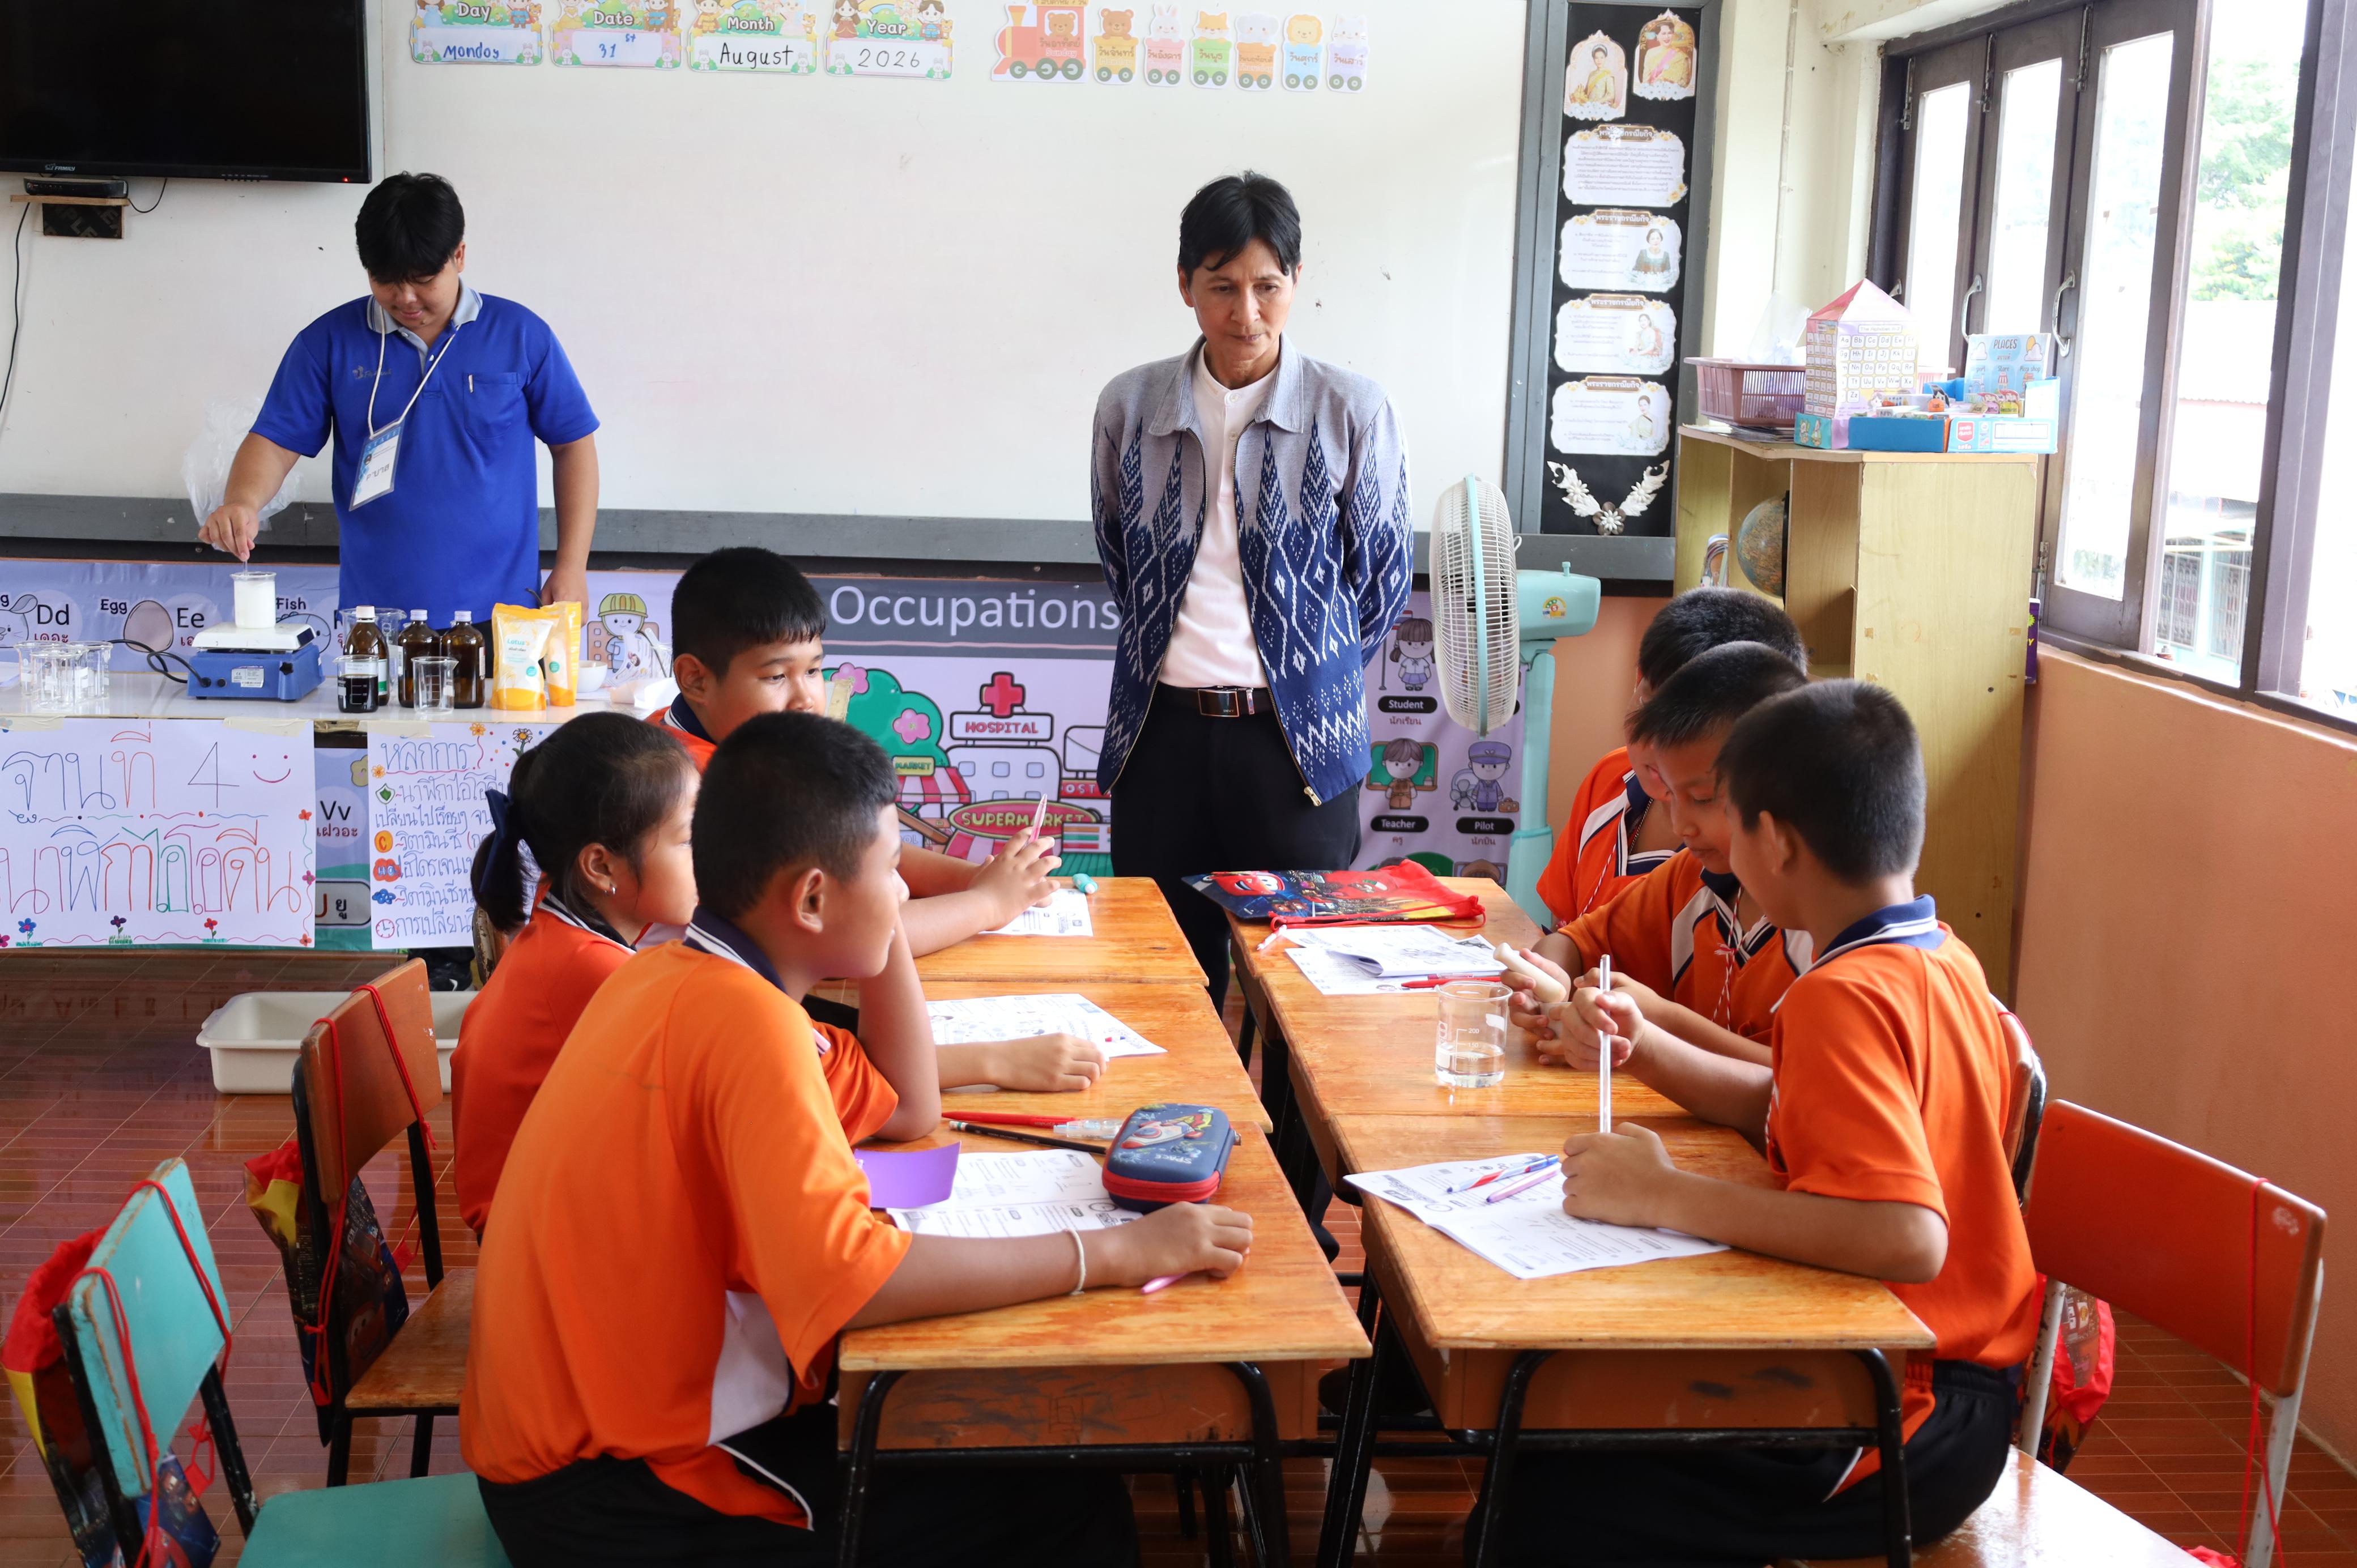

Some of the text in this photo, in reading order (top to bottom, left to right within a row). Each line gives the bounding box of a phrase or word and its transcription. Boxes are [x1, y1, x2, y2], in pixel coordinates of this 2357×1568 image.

[458, 2, 491, 20] Day
[594, 12, 634, 27] Date
[726, 16, 775, 32] Month
[867, 19, 907, 36] Year
[599, 43, 616, 58] 31
[720, 42, 794, 69] August
[858, 48, 921, 68] 2026
[1199, 49, 1223, 63] วันพุธ
[1290, 52, 1319, 66] วันศุกร์
[1993, 339, 2018, 350] PLACES
[101, 599, 127, 615] Egg
[276, 597, 307, 610] Fish
[830, 586, 1121, 636] Occupations
[37, 604, 69, 625] Dd
[177, 607, 205, 628] Ee
[1388, 700, 1424, 710] Student
[965, 722, 1039, 734] HOSPITAL
[1389, 715, 1422, 726] นักเรียน
[188, 742, 240, 808] 4
[320, 800, 351, 821] Vv
[1381, 819, 1416, 829] Teacher
[1474, 821, 1494, 830] Pilot
[1392, 837, 1403, 846] ครู
[1471, 836, 1496, 846] นักบิน
[336, 899, 348, 919] ยู
